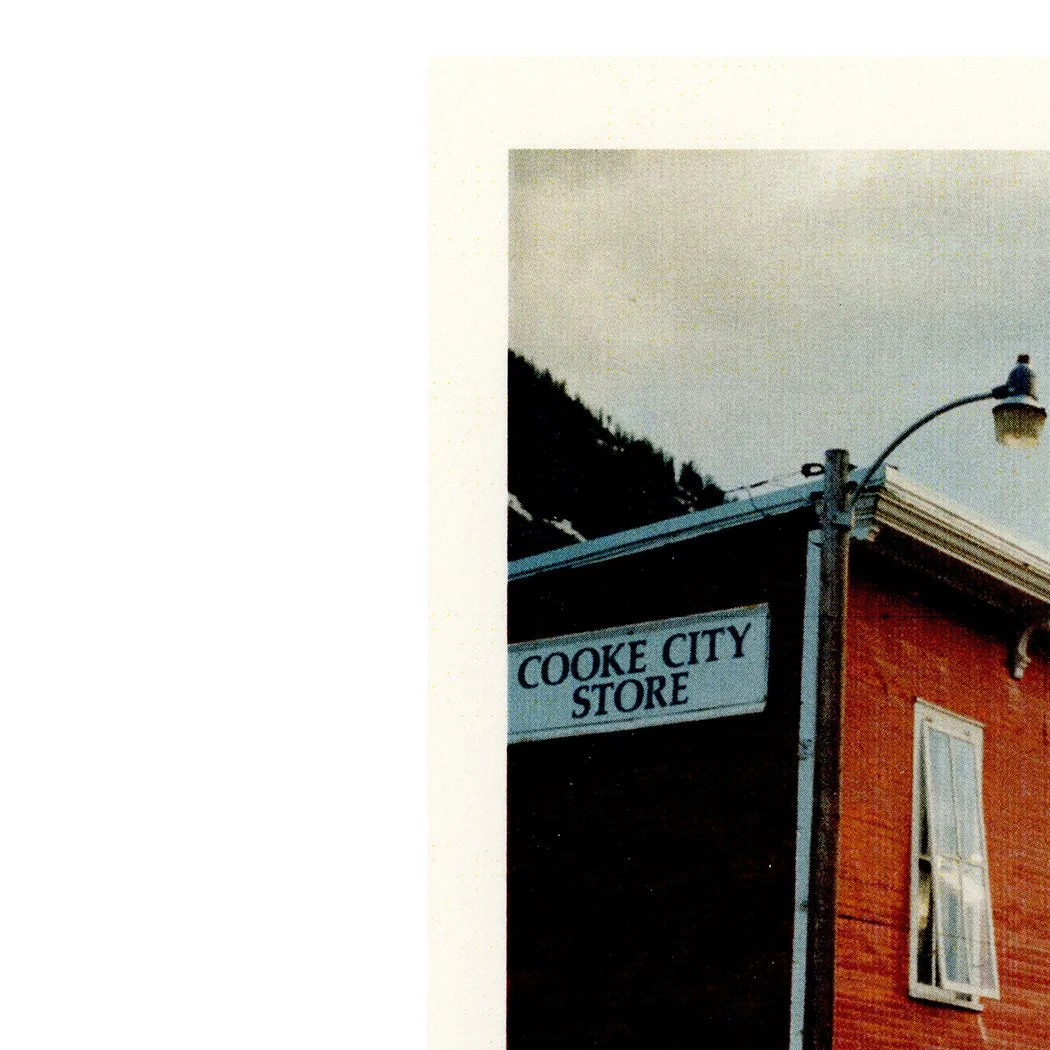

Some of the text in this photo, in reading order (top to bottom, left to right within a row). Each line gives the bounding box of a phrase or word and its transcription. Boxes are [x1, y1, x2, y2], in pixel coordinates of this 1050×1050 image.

[517, 623, 752, 690] COOKE CITY
[571, 672, 689, 719] STORE
